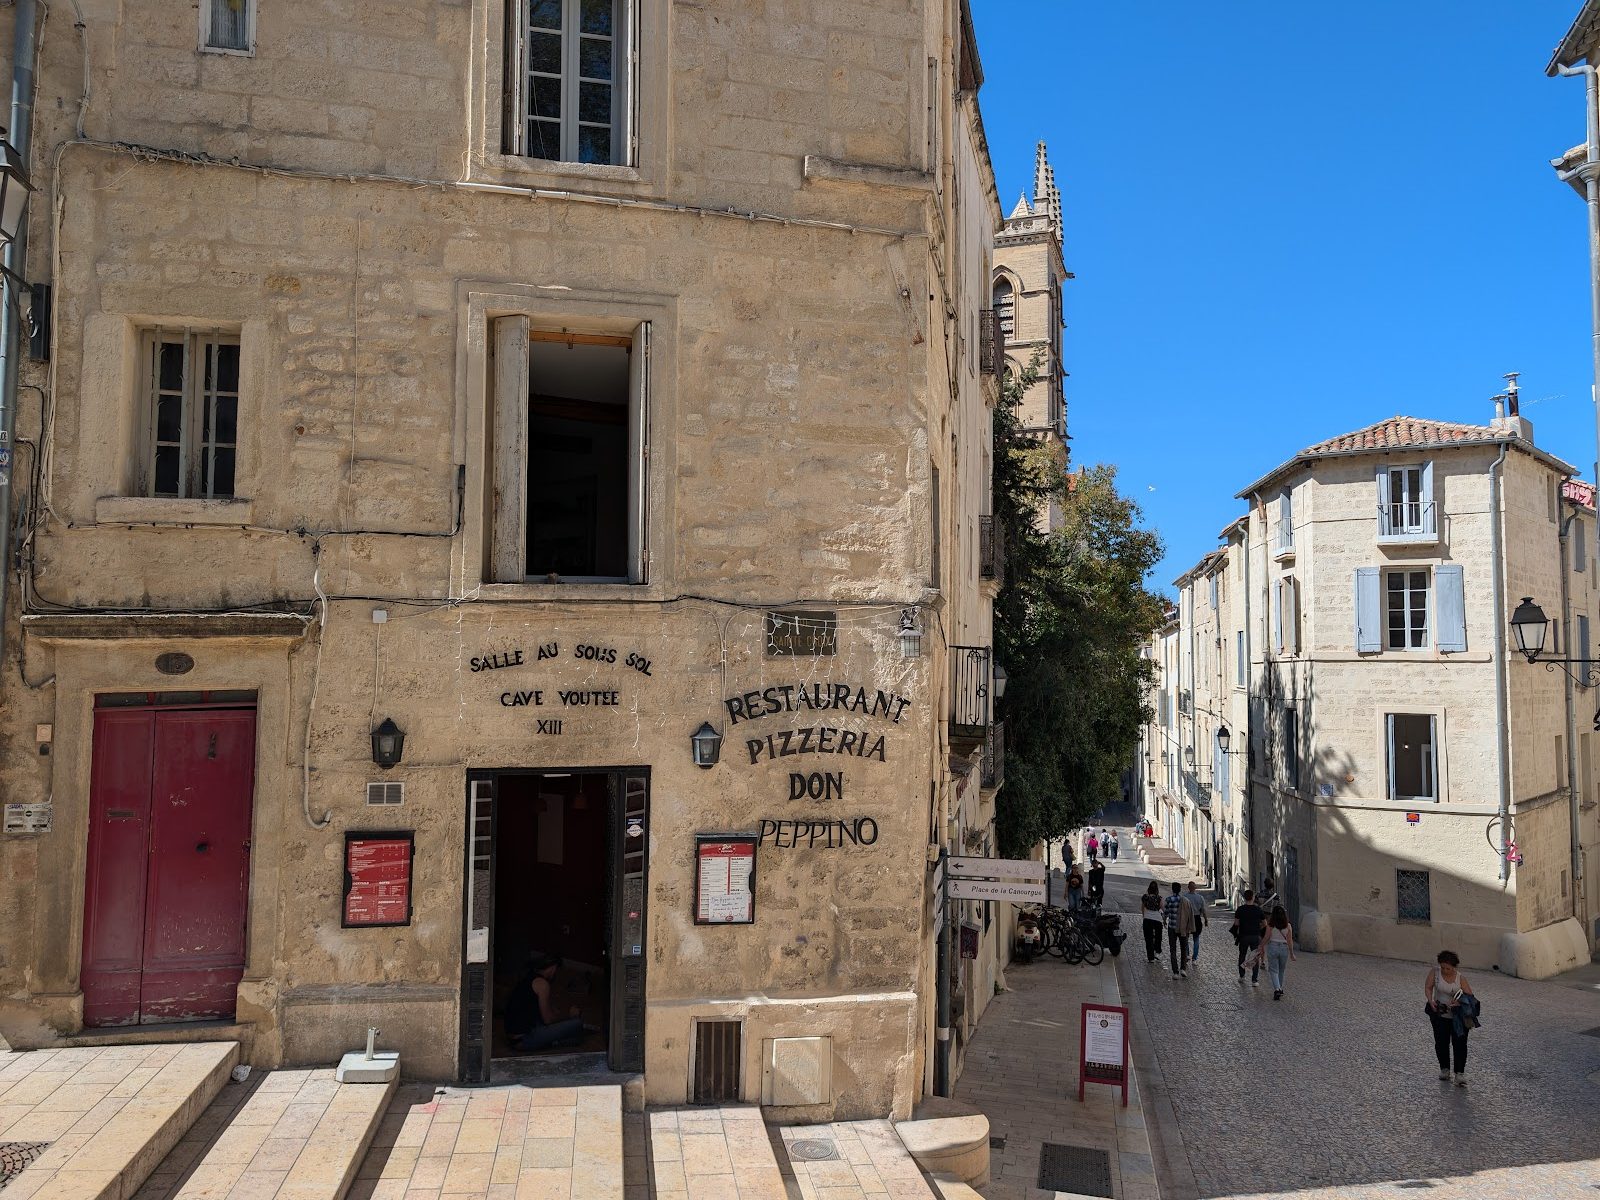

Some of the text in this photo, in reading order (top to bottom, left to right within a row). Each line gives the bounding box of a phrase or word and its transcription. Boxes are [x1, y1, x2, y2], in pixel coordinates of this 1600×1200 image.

[470, 642, 652, 676] SALLE AU SOUS SOL
[500, 690, 619, 707] CAVE VOUTEE
[724, 683, 912, 725] RESTAURANT
[536, 719, 563, 735] XIII
[746, 727, 887, 765] PIZZERIA
[788, 771, 844, 801] DON
[758, 817, 879, 849] PEPPINO
[971, 885, 989, 894] Place
